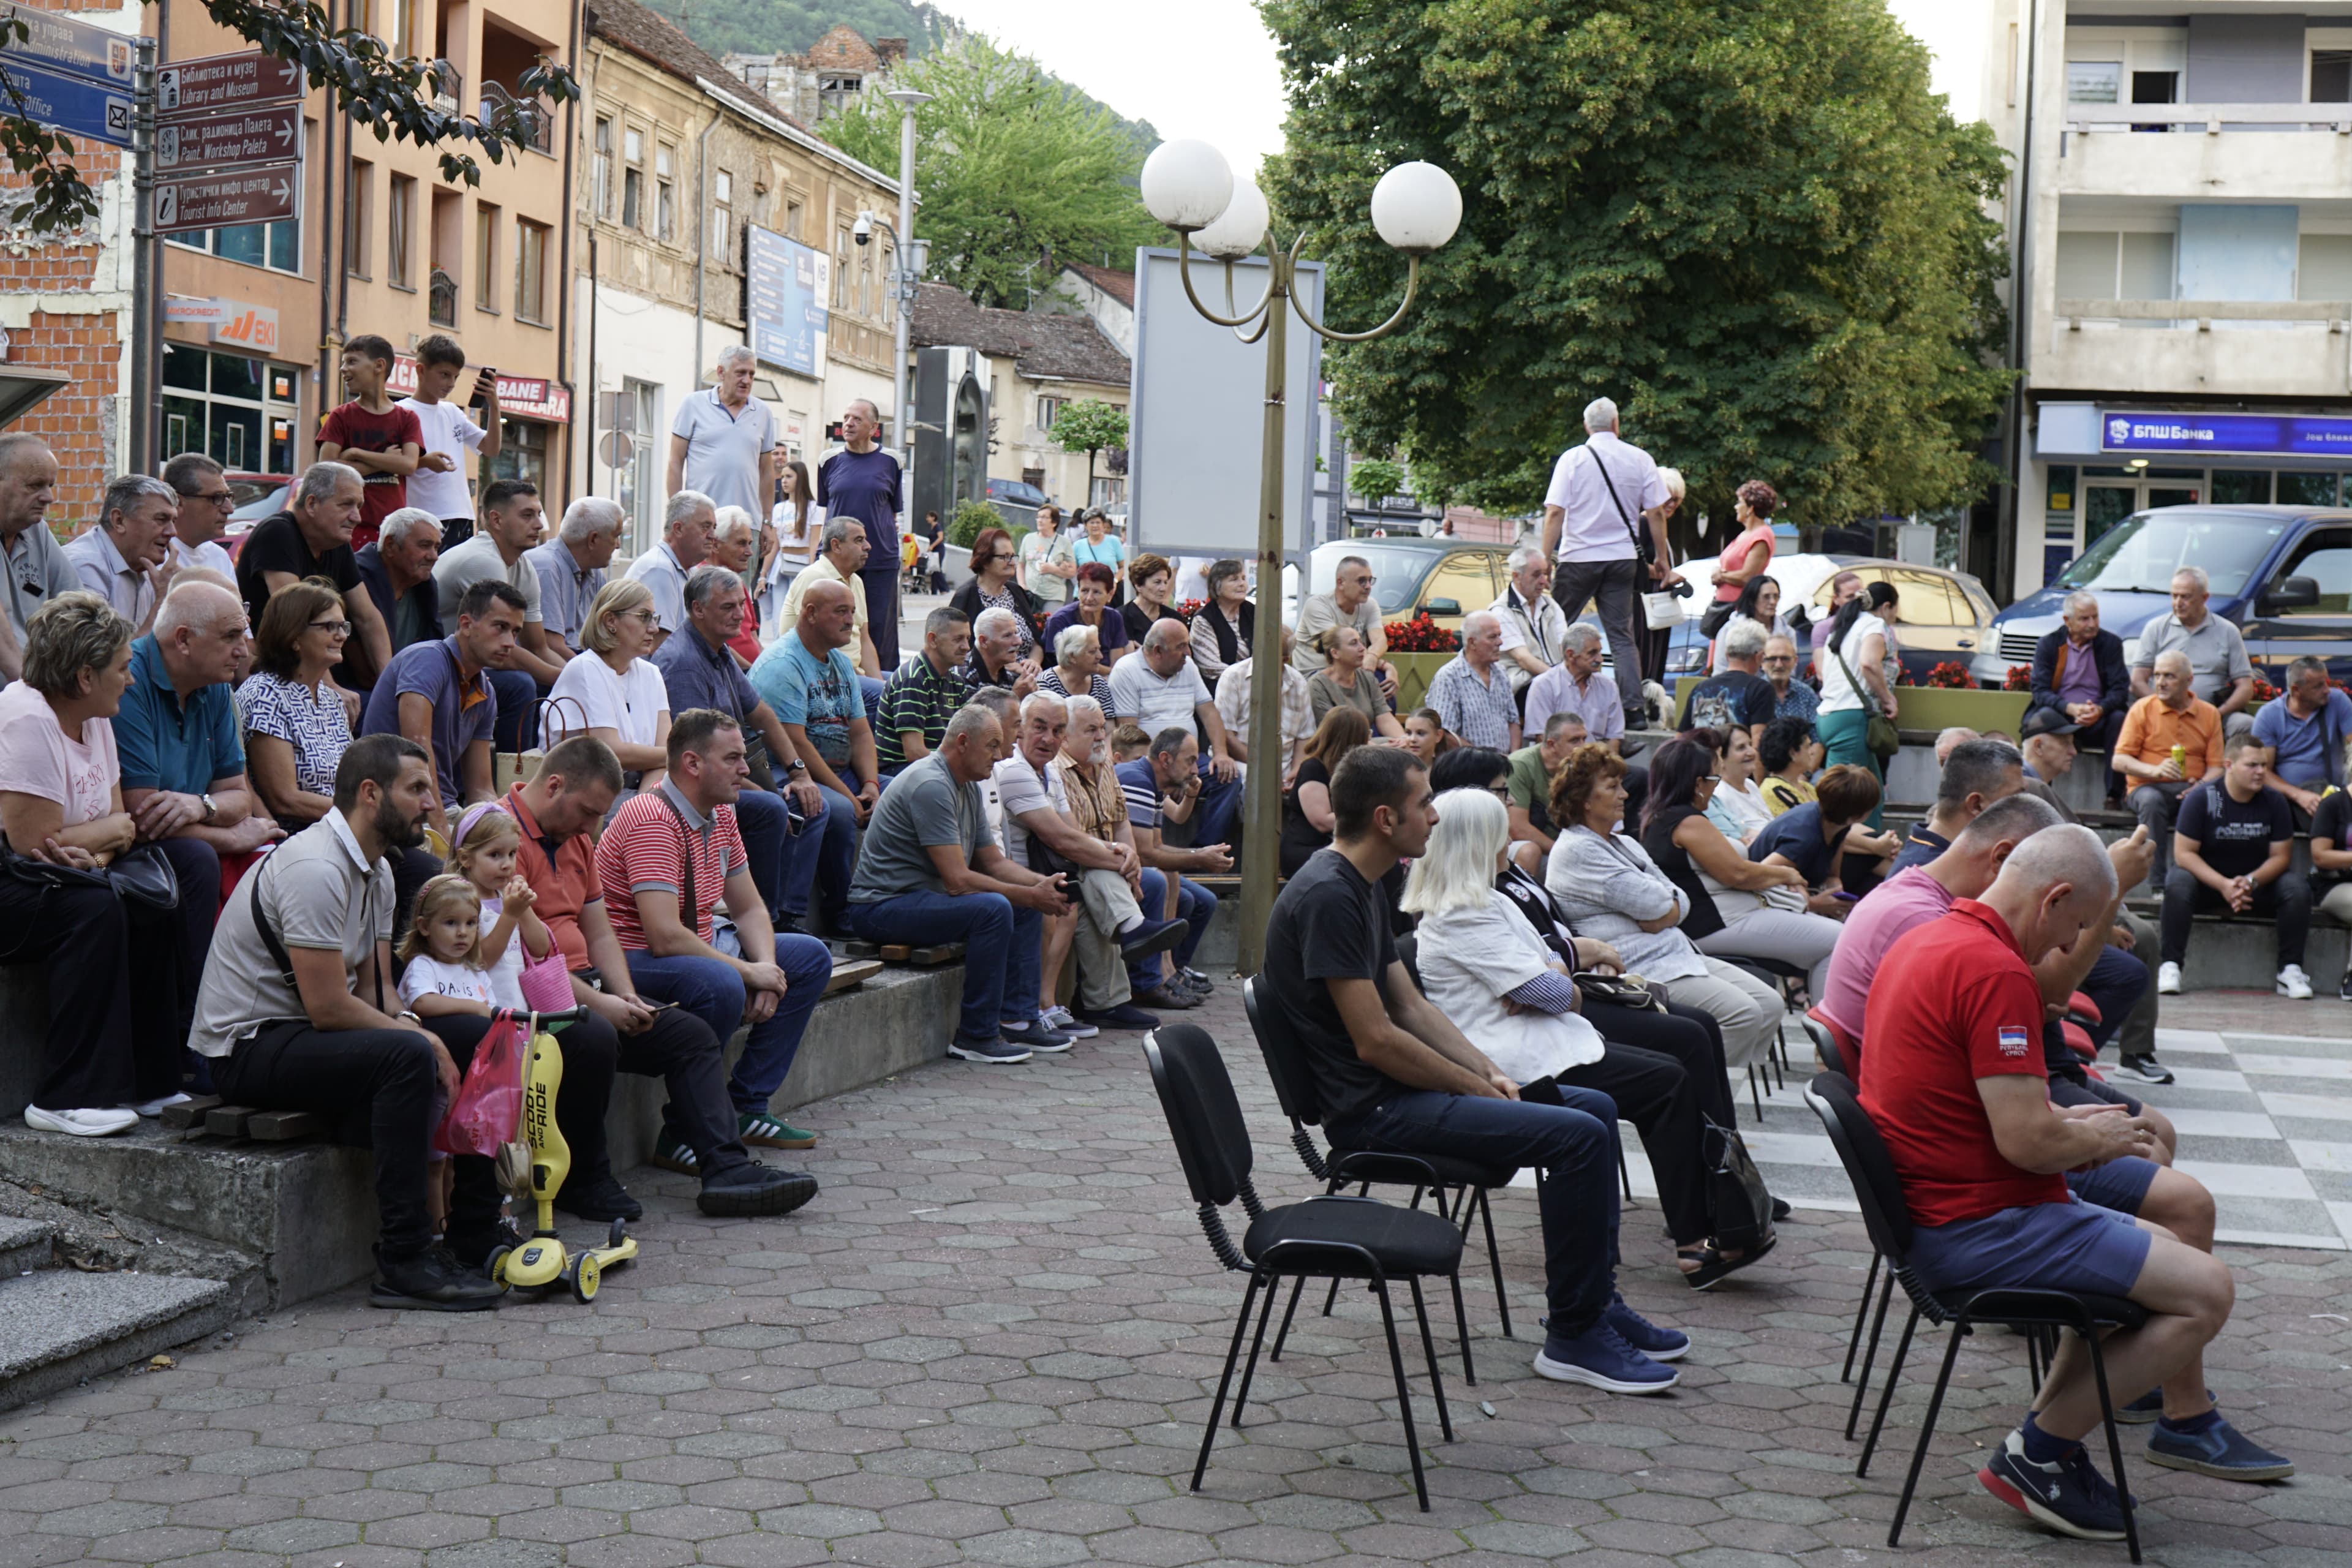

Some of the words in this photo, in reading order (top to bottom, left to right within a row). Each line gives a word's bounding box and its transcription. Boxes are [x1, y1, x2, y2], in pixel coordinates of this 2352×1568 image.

[42, 23, 74, 43] управа
[22, 38, 91, 67] Administration
[181, 66, 225, 84] Библиотека
[227, 65, 232, 76] и
[234, 58, 257, 78] музеј
[24, 95, 53, 116] Office
[182, 88, 209, 105] Library
[211, 83, 225, 99] and
[226, 82, 258, 97] Museum
[181, 126, 200, 141] Слик.
[202, 122, 243, 143] радионица
[245, 118, 272, 134] Палета
[181, 146, 201, 162] Paint.
[204, 142, 241, 160] Workshop
[242, 138, 268, 155] Paleta
[179, 184, 219, 203] Туристички
[221, 180, 241, 196] инфо
[243, 178, 270, 194] центар
[180, 205, 206, 221] Tourist
[207, 201, 221, 218] Info
[223, 200, 248, 216] Center
[254, 319, 275, 346] EKI
[496, 380, 541, 400] BANE
[536, 1082, 547, 1128] RIDE
